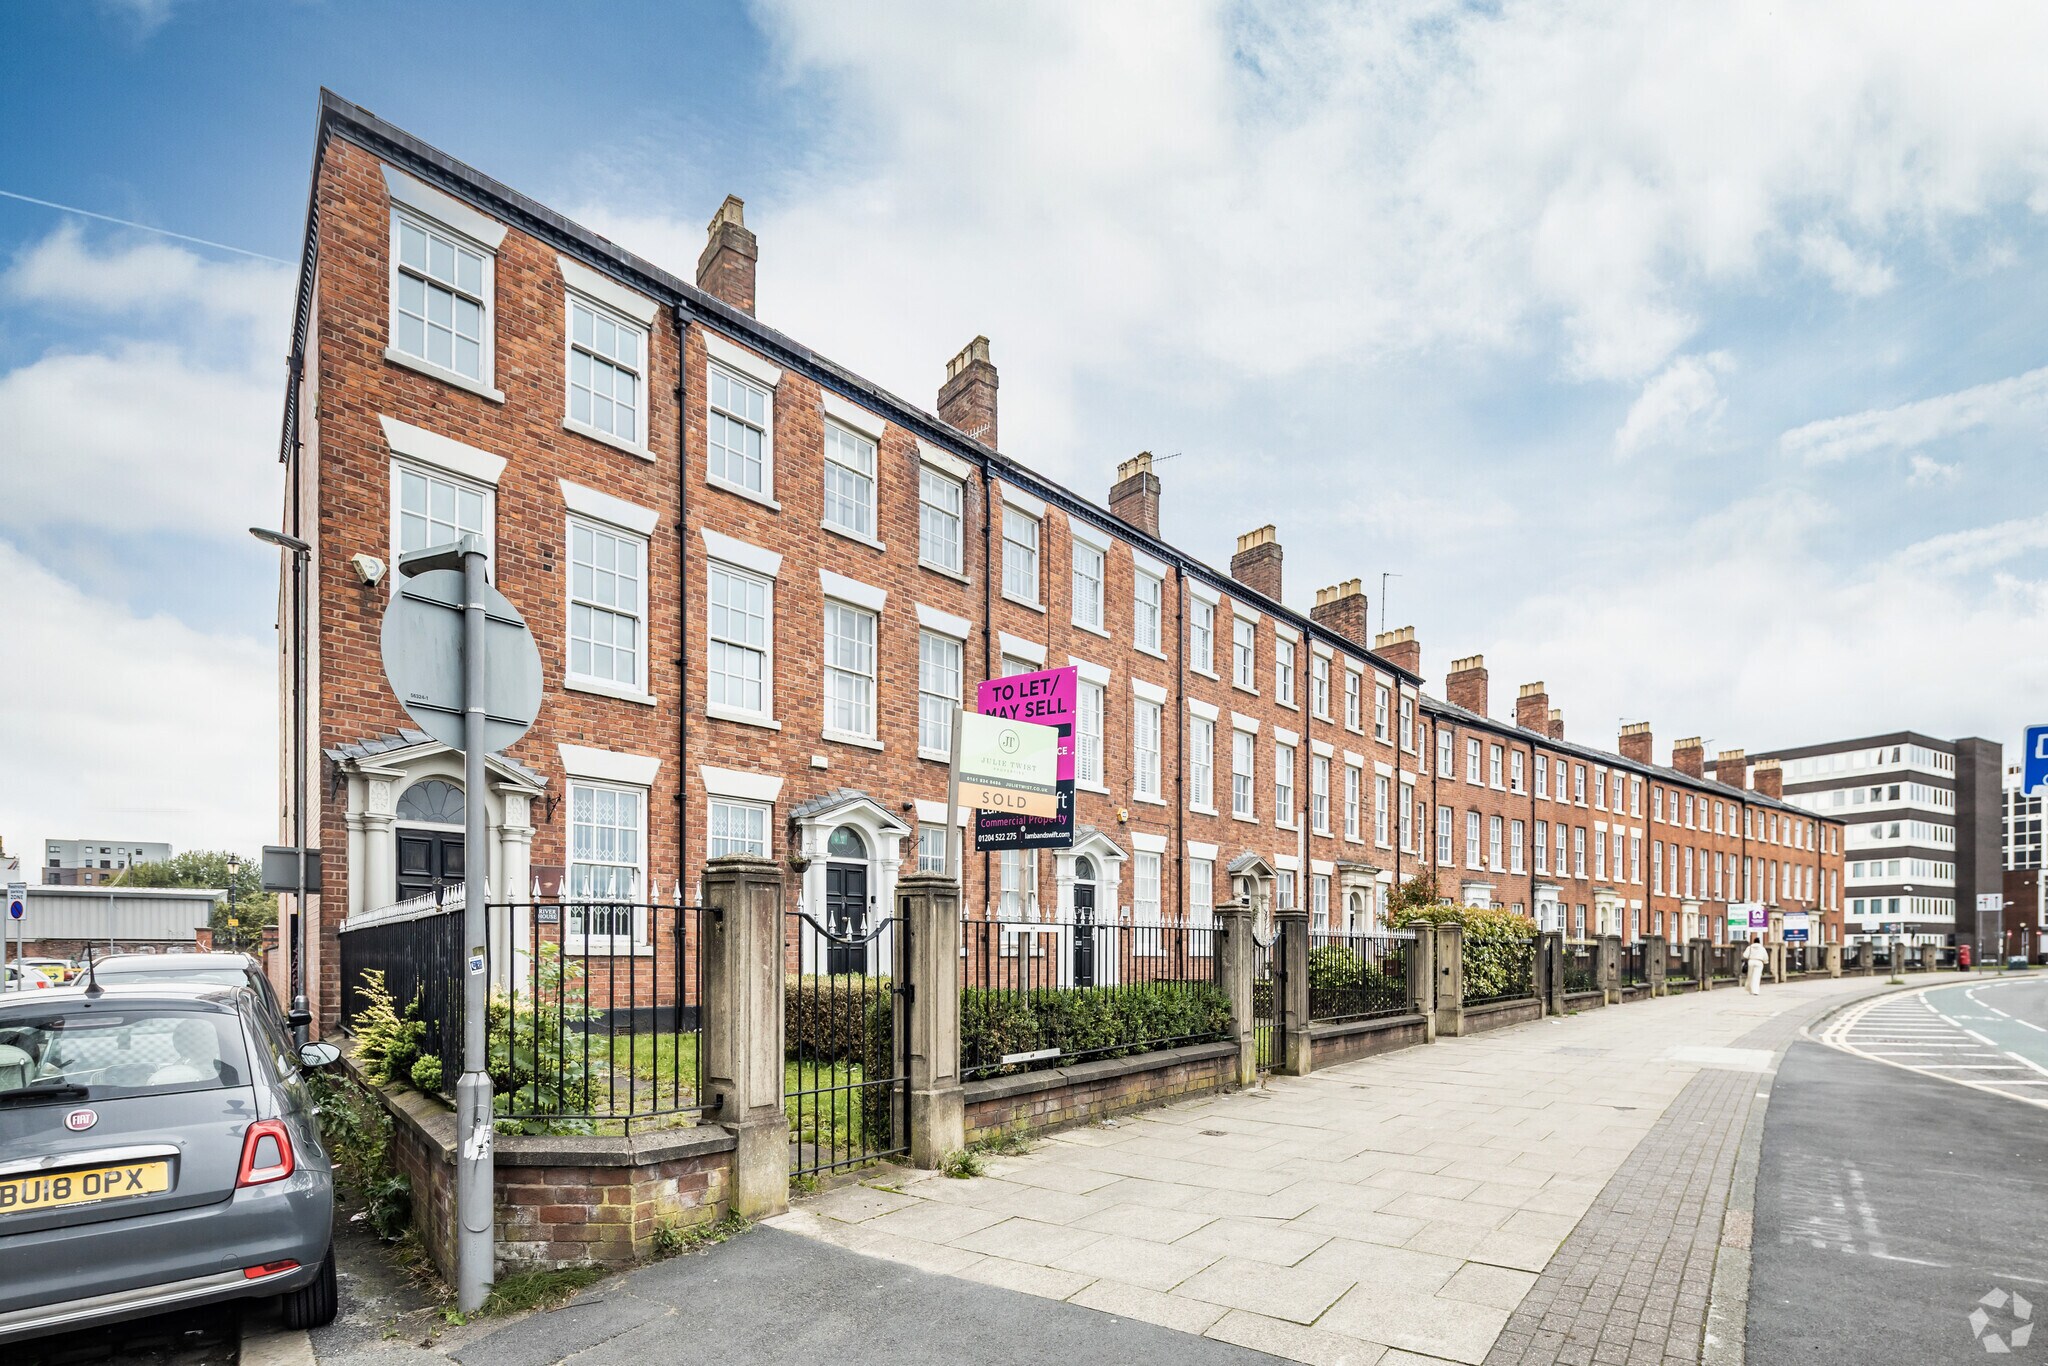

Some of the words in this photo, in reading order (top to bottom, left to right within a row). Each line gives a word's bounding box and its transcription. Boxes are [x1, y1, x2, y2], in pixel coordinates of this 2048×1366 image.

[992, 685, 1014, 702] TO
[1020, 674, 1060, 698] LET/
[1025, 698, 1067, 717] SELL
[981, 757, 1007, 767] JULIE
[1010, 761, 1037, 772] TWIST
[982, 791, 1027, 808] SOLD
[980, 815, 1026, 828] Commercial
[978, 834, 995, 842] 01204
[995, 833, 1005, 841] 522
[1006, 832, 1017, 840] 275
[1024, 831, 1070, 839] lambandswift.com
[432, 876, 442, 884] 22
[72, 1114, 91, 1125] FIAT
[0, 1177, 71, 1206] BU18
[83, 1168, 143, 1195] OPX
